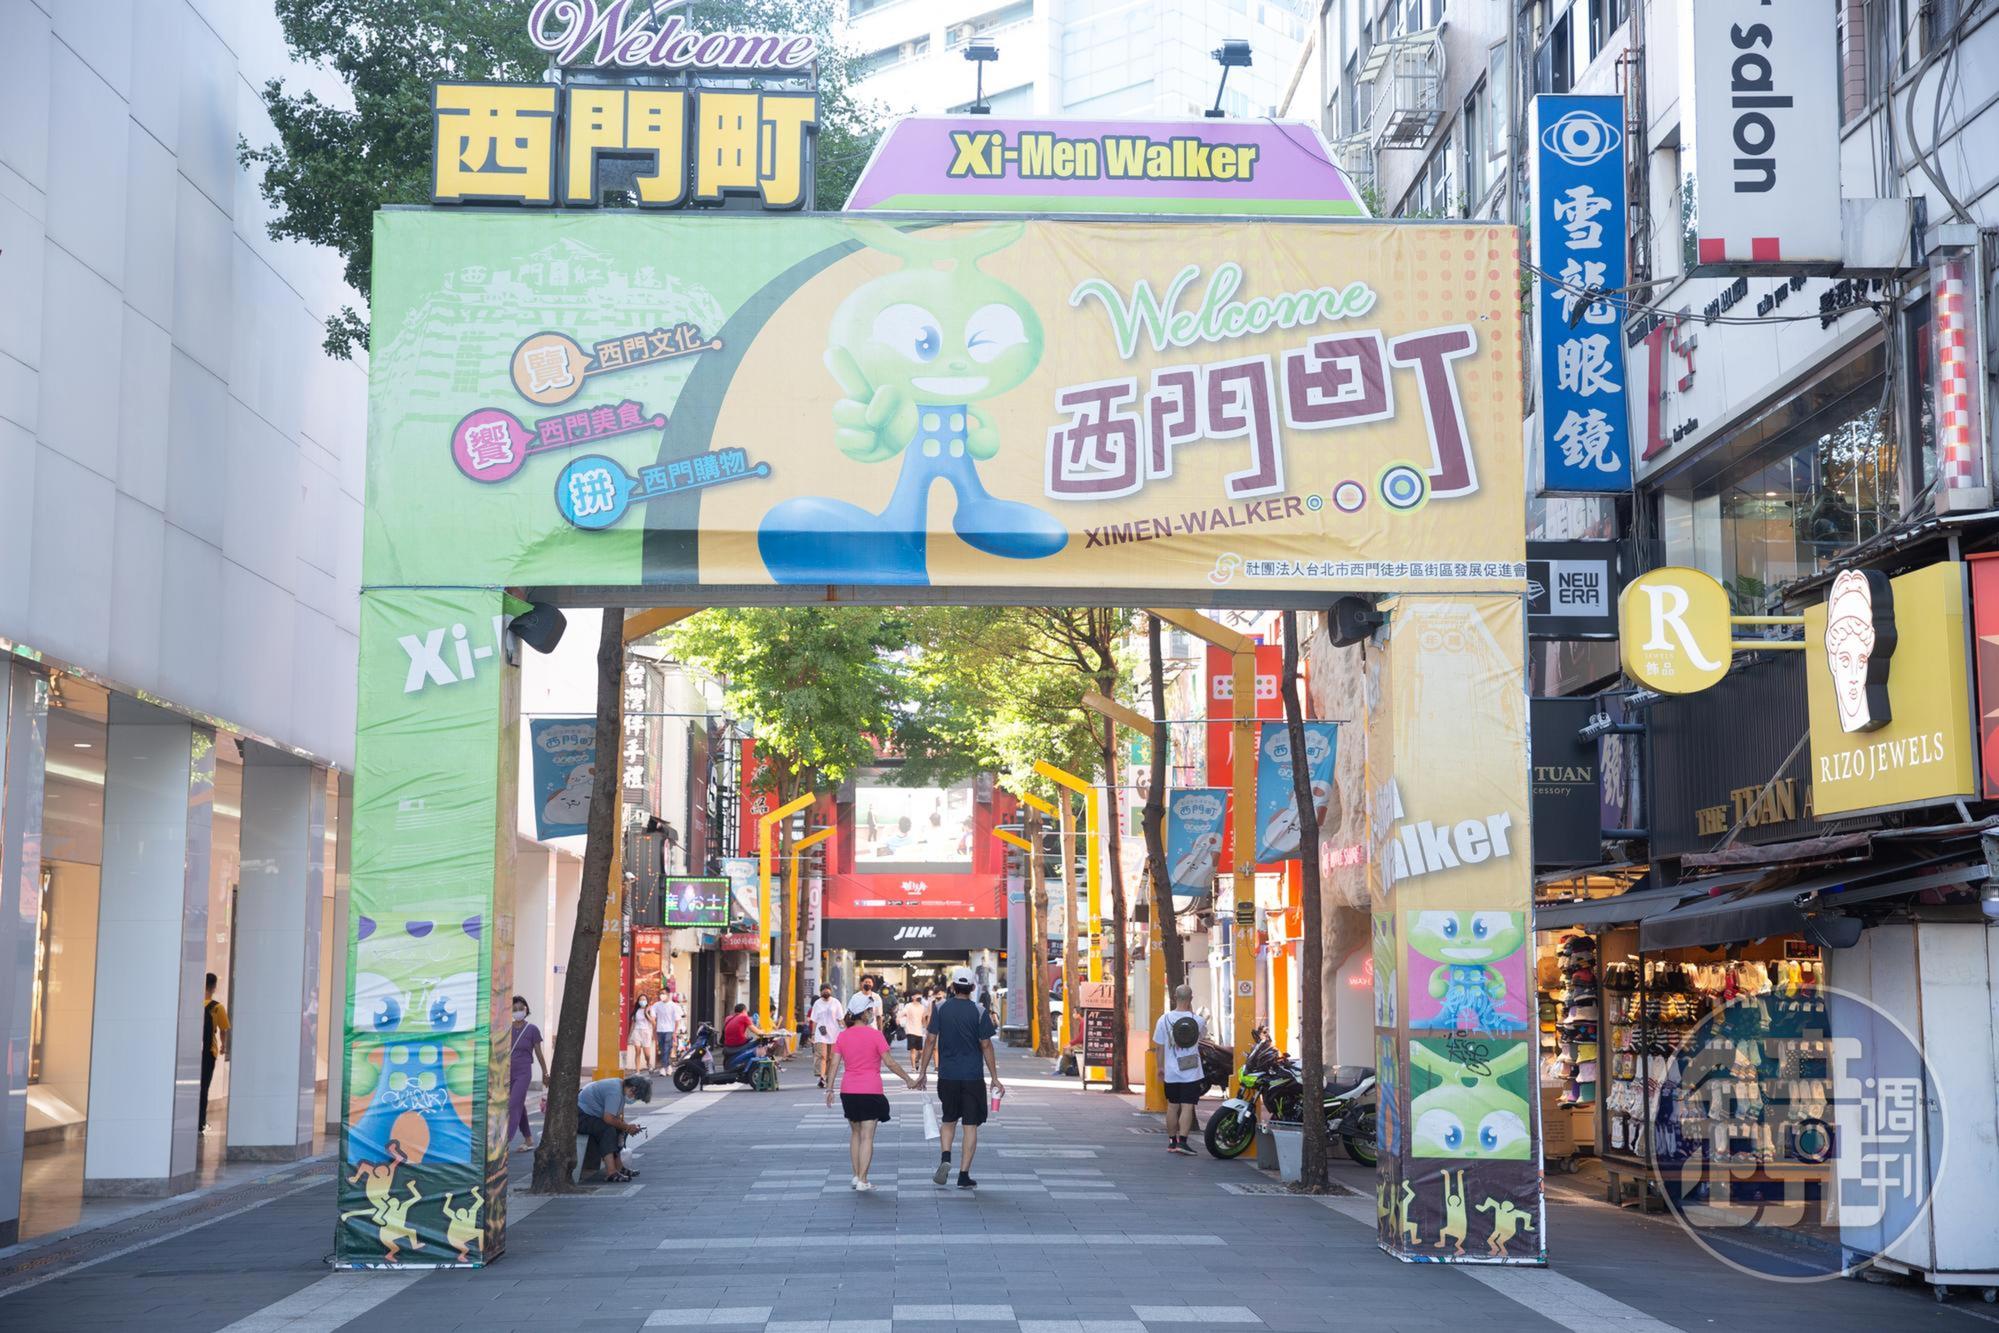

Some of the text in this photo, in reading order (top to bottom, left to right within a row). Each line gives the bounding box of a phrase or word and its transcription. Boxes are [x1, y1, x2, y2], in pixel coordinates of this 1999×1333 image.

[528, 0, 818, 69] Welcome
[1730, 22, 1793, 193] salon
[431, 83, 818, 208] 西門町
[948, 131, 1259, 182] Xi-Men Walker
[1068, 261, 1376, 360] Welcome
[1552, 184, 1622, 472] 雪龍眼鏡
[596, 323, 701, 368] 西門文化
[538, 401, 645, 445] 西門美食
[1045, 323, 1480, 500] 西門町
[642, 448, 746, 493] 西門購物
[1083, 494, 1304, 550] XIMEN-WALKER
[1245, 560, 1527, 579] 社團法人台北市西門徒步區街區發展促進會
[1558, 572, 1599, 588] NEW
[1559, 588, 1600, 604] ERA
[397, 614, 512, 693] Xi-
[1639, 584, 1722, 672] R
[1534, 766, 1593, 782] TUAN
[1819, 732, 1945, 786] RIZO JEWELS
[1695, 804, 1729, 836] THE
[1730, 777, 1798, 828] TUAN
[893, 926, 934, 941] JUN
